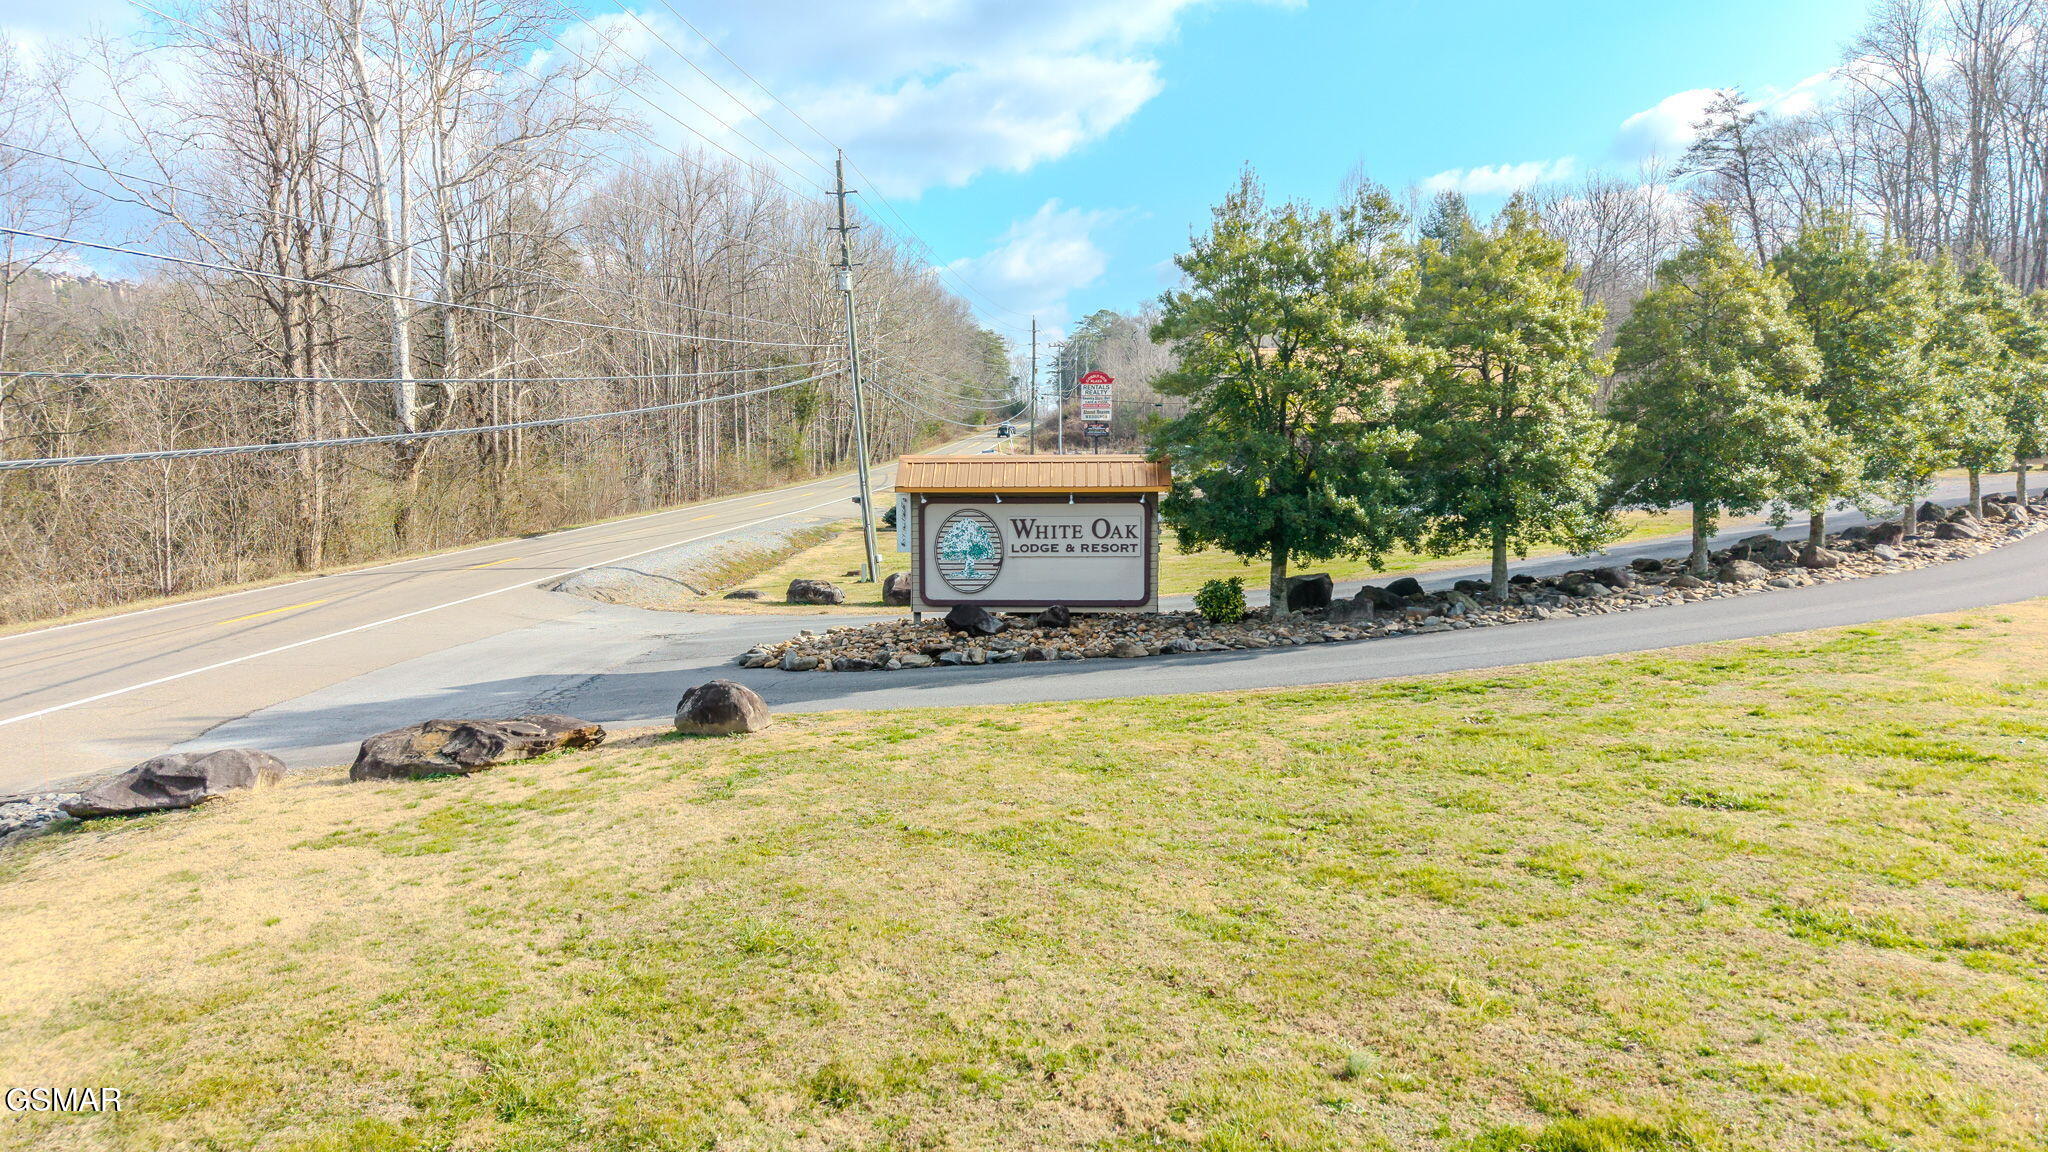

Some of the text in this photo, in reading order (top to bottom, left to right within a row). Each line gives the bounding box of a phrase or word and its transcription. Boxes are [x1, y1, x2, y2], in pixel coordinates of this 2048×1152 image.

[1091, 518, 1138, 539] OAK
[1011, 543, 1138, 553] LODGE & RESORT
